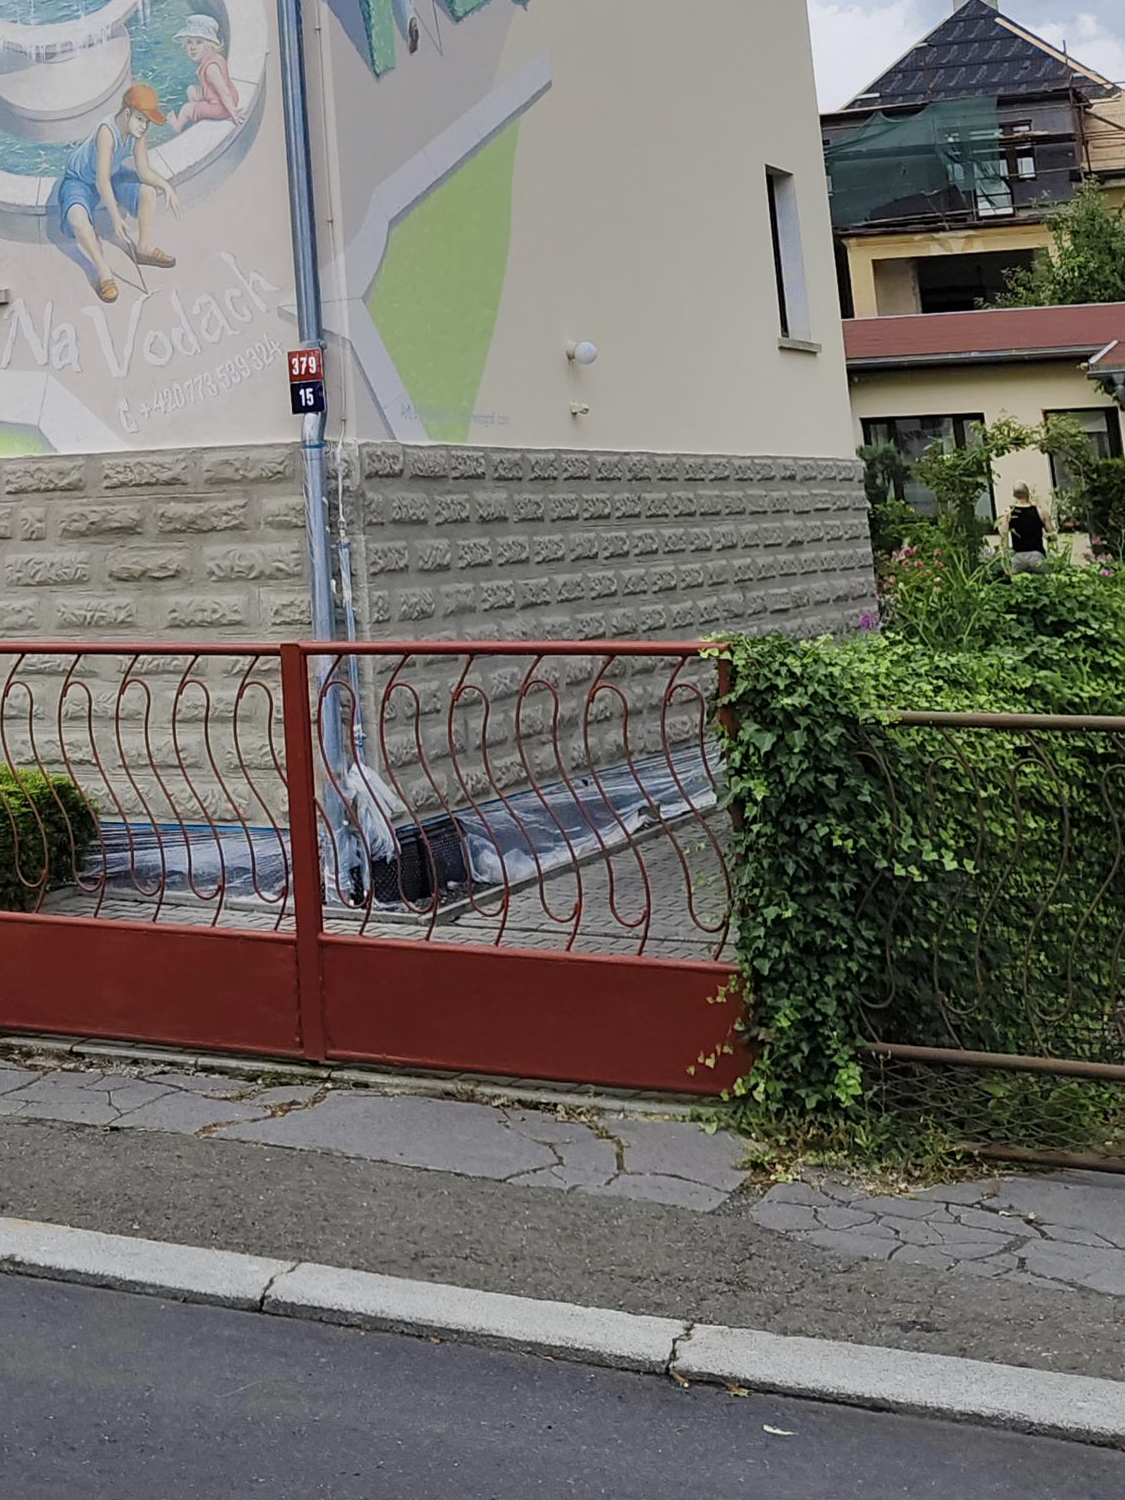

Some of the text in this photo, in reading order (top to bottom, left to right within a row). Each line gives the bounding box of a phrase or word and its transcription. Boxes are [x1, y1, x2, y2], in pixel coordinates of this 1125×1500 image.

[1, 251, 281, 378] Na Vodach
[291, 355, 317, 376] 379
[299, 387, 315, 407] 15
